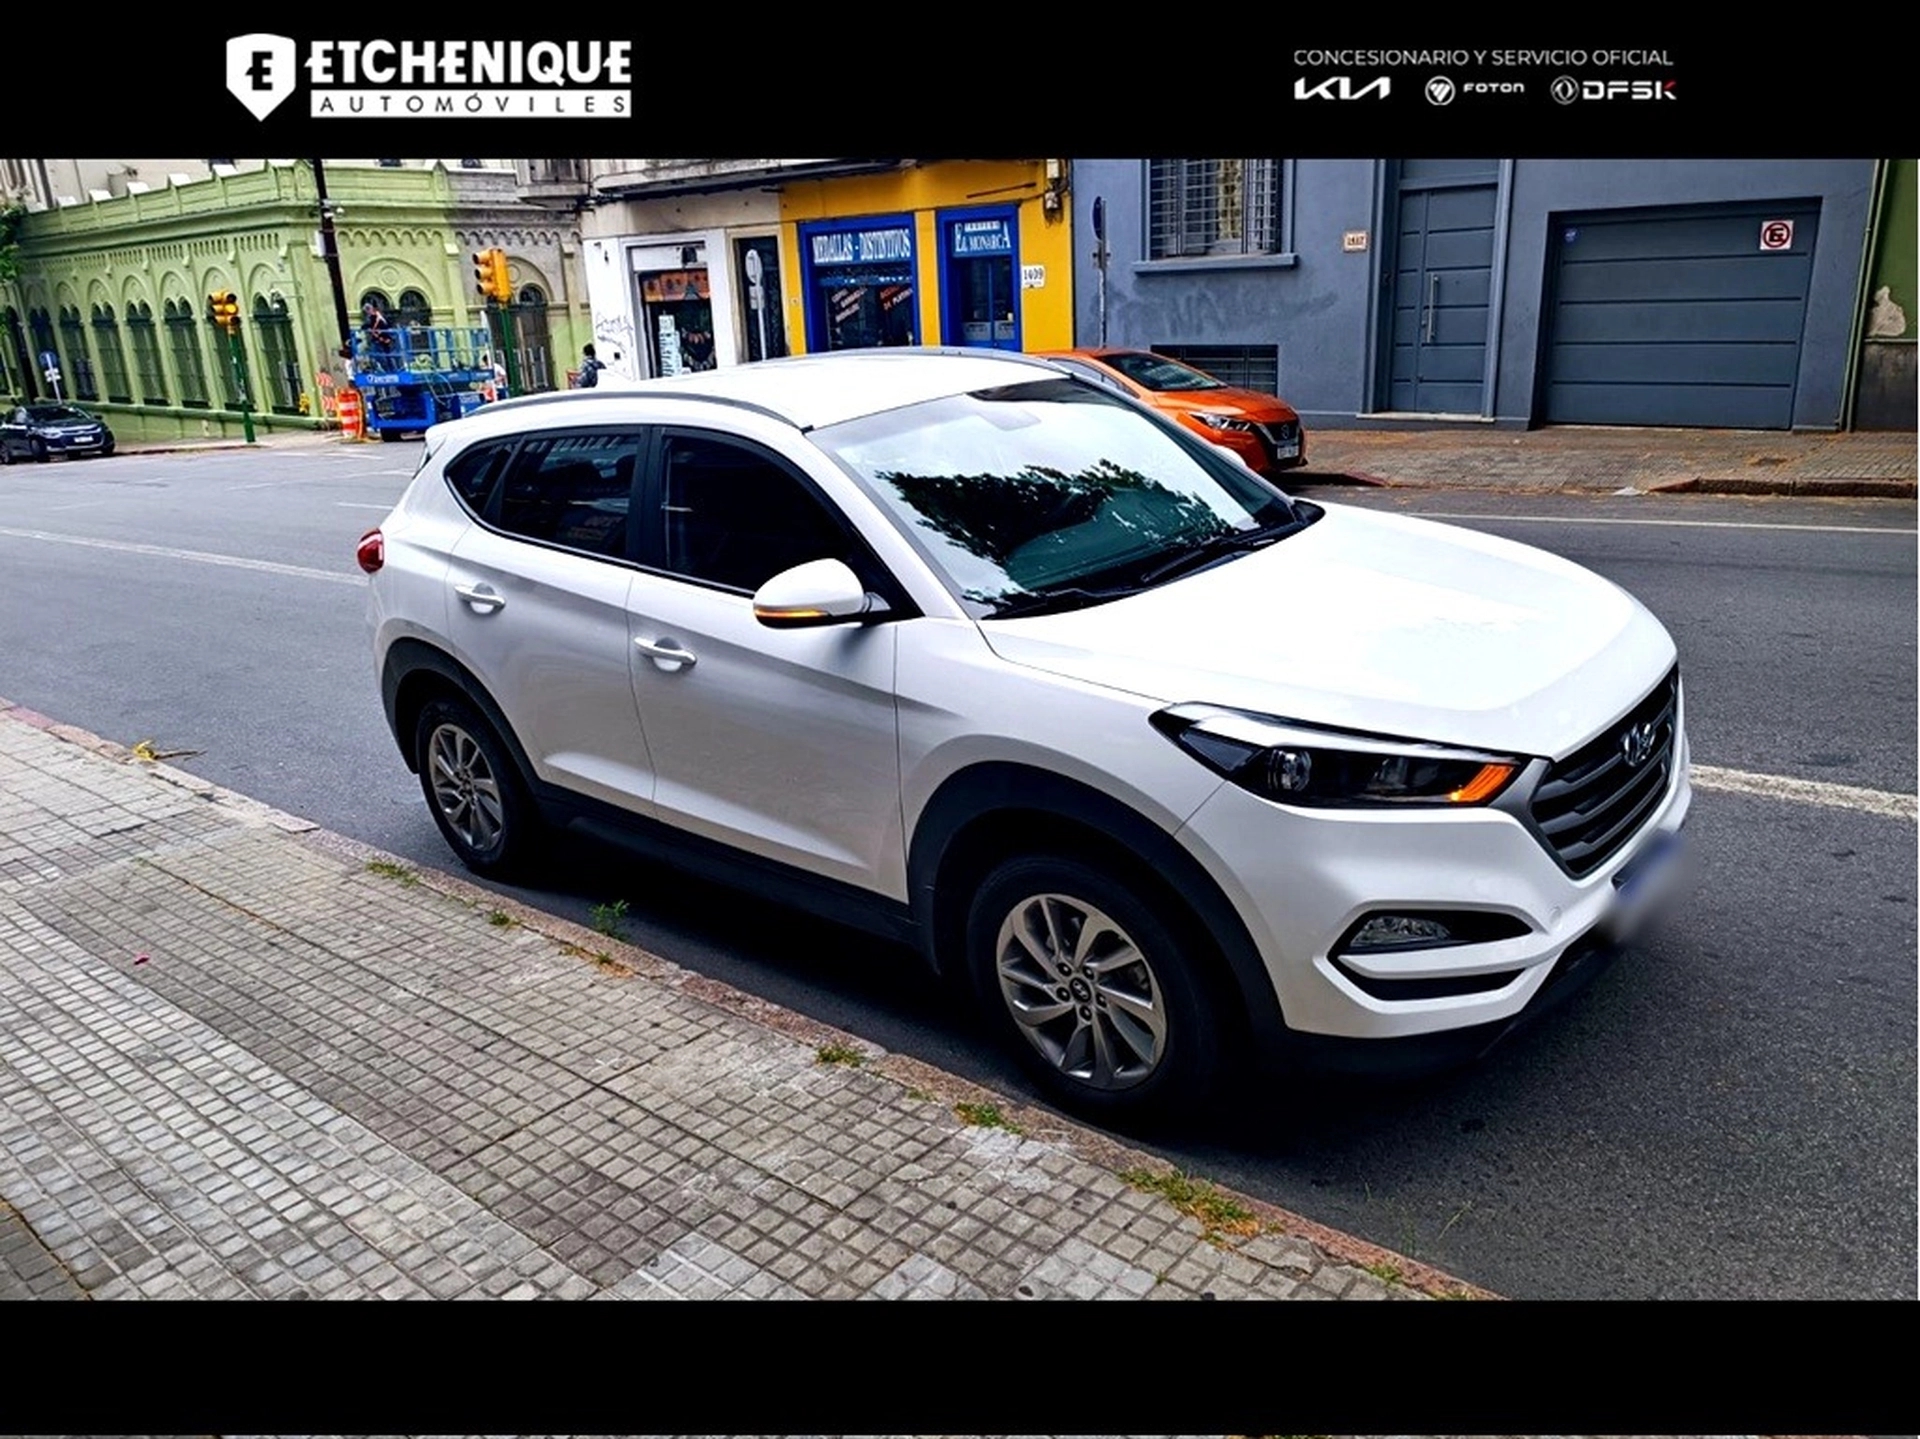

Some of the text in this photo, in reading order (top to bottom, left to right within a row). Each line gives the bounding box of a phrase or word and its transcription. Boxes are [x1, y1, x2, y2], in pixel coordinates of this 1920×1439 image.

[812, 233, 853, 263] MEDALLAS
[859, 228, 911, 260] DISTINTIVOS
[1023, 267, 1044, 280] 1409
